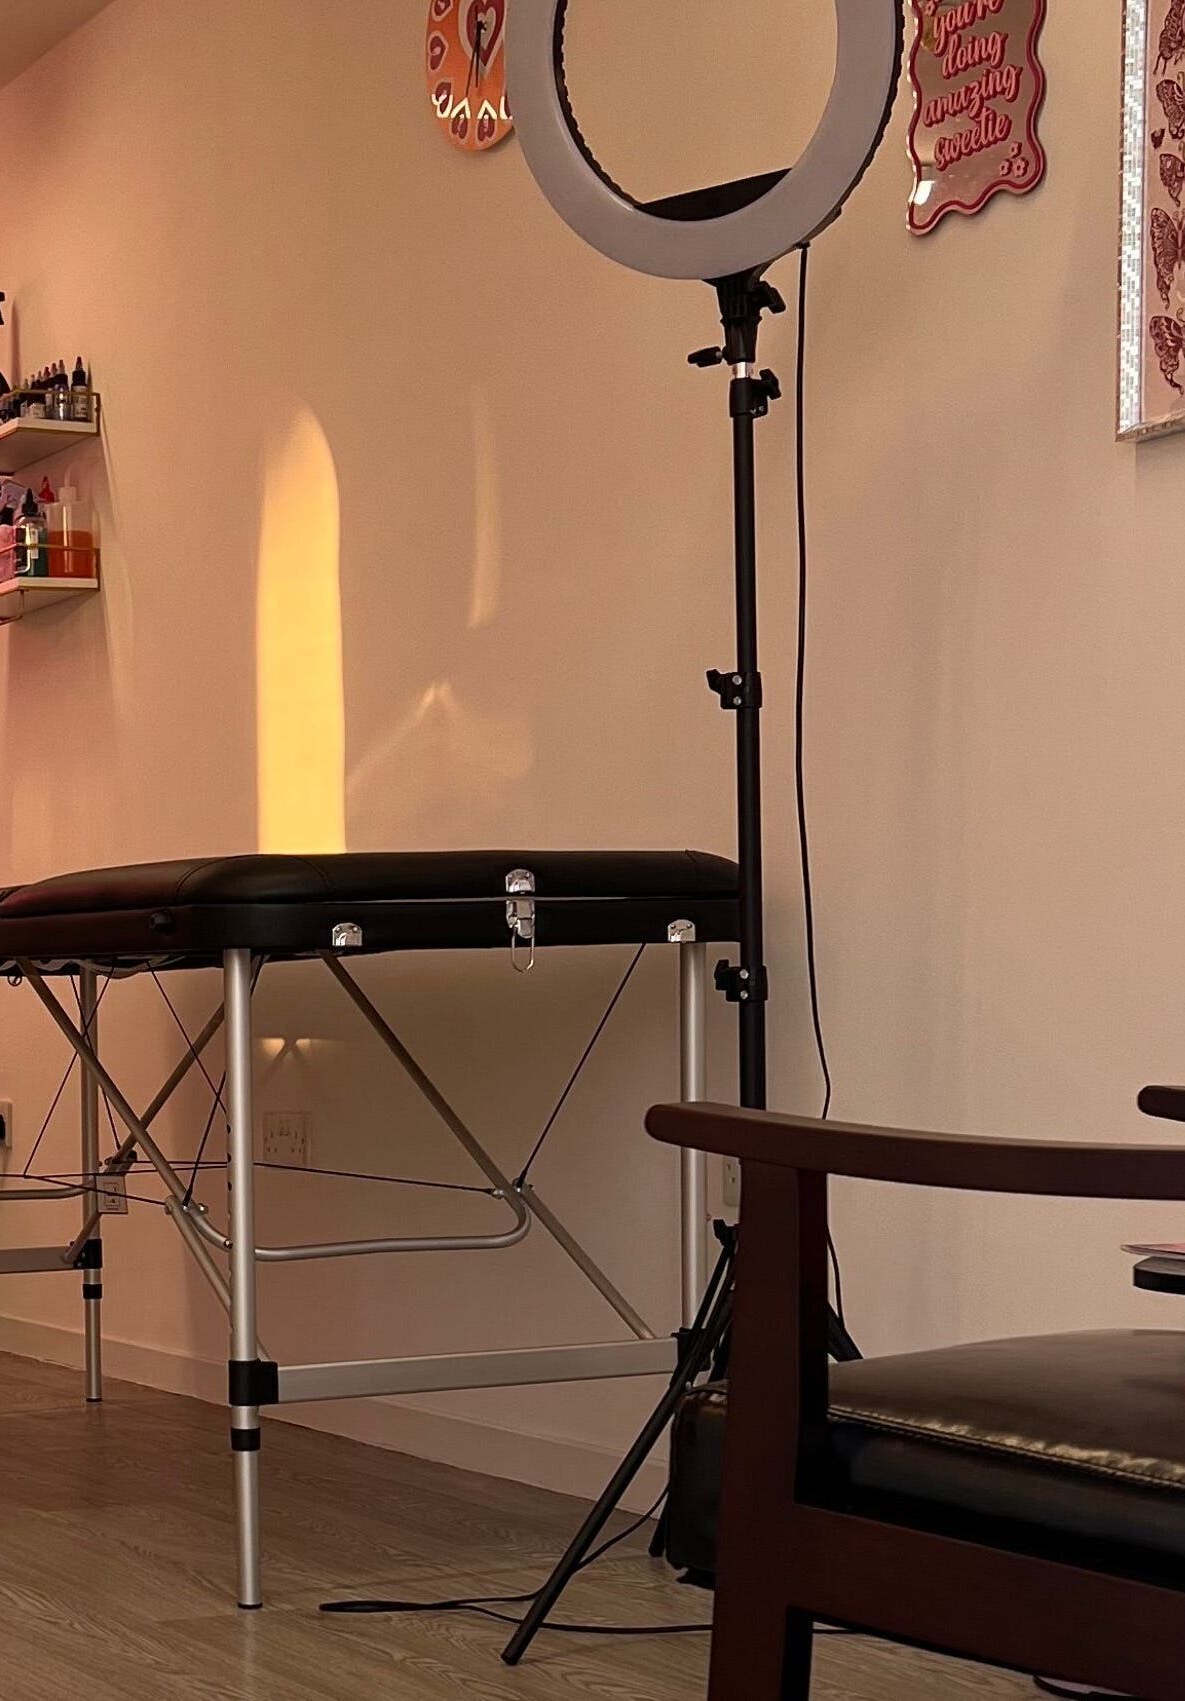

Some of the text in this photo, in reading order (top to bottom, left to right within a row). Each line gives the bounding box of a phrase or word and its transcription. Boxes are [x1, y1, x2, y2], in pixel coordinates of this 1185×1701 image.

[933, 0, 1005, 57] youre
[942, 31, 1008, 79] doing
[923, 64, 1023, 127] amazing
[933, 105, 1012, 171] sweetie
